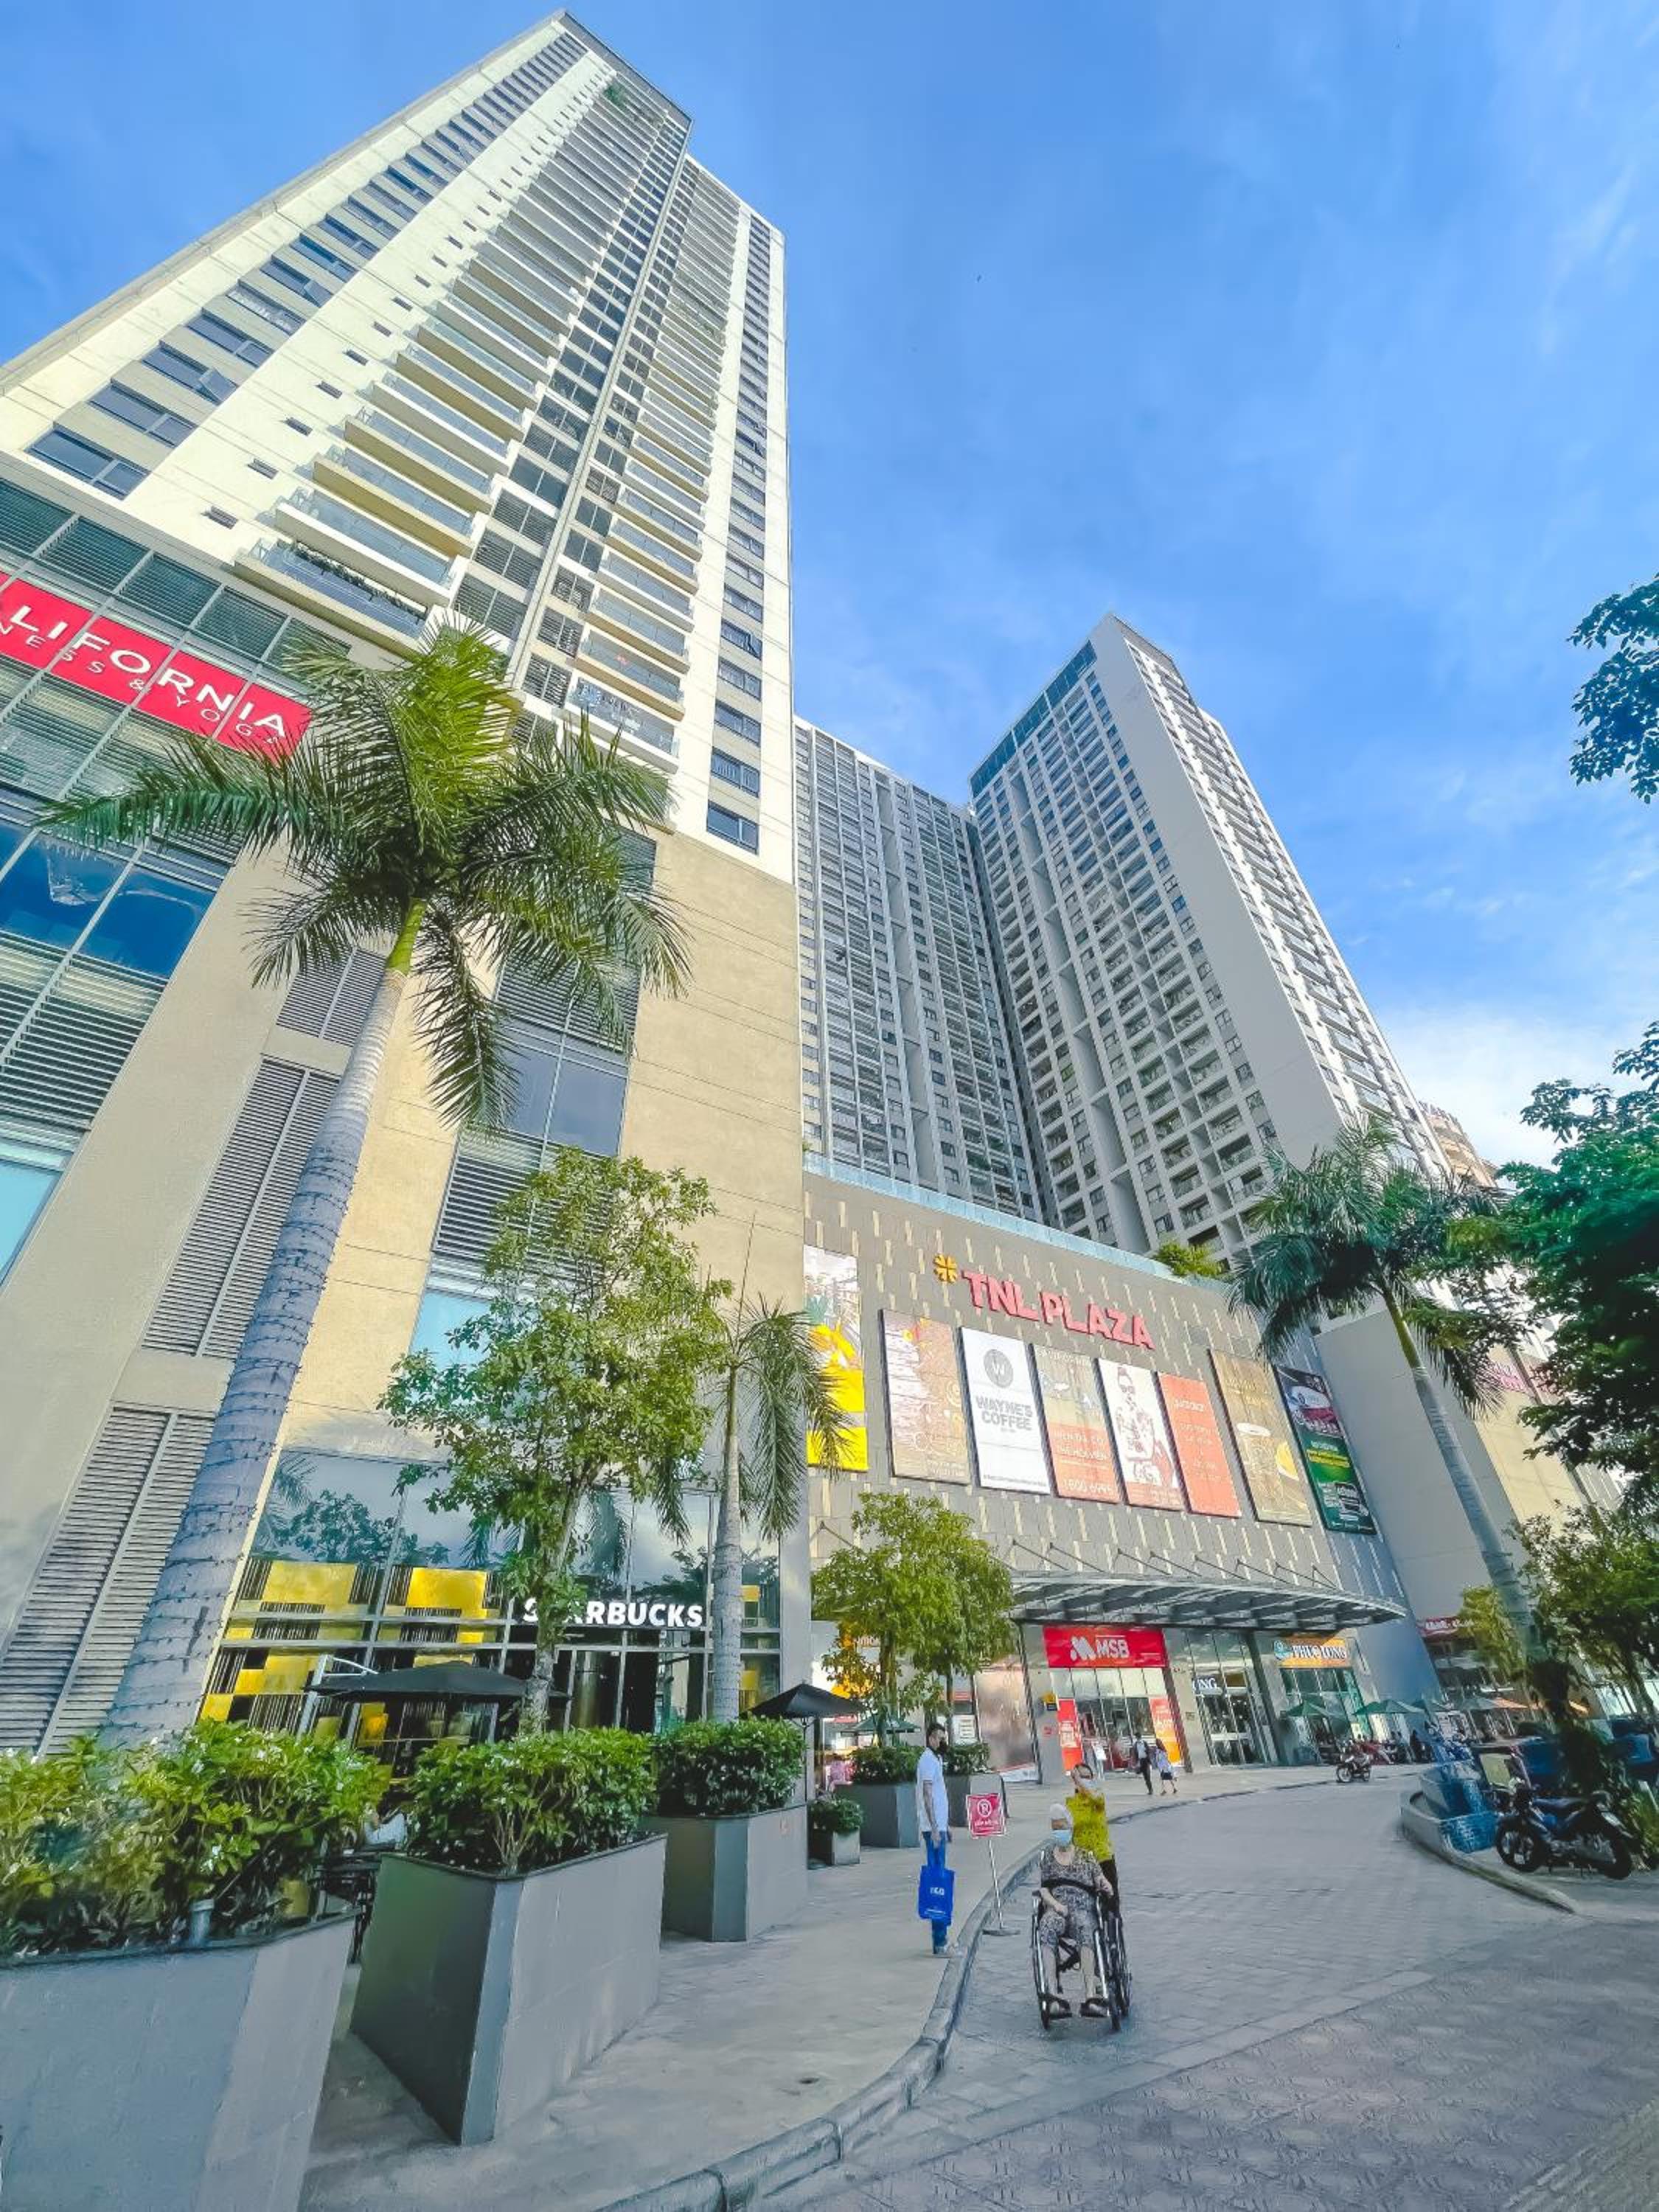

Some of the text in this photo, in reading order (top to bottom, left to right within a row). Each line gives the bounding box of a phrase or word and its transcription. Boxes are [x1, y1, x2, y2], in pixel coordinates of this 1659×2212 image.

[961, 1270, 1157, 1350] TNL PLAZA
[981, 1411, 1033, 1431] COFFEE
[523, 1597, 703, 1627] SRBUCKS
[1096, 1639, 1130, 1658] MSB
